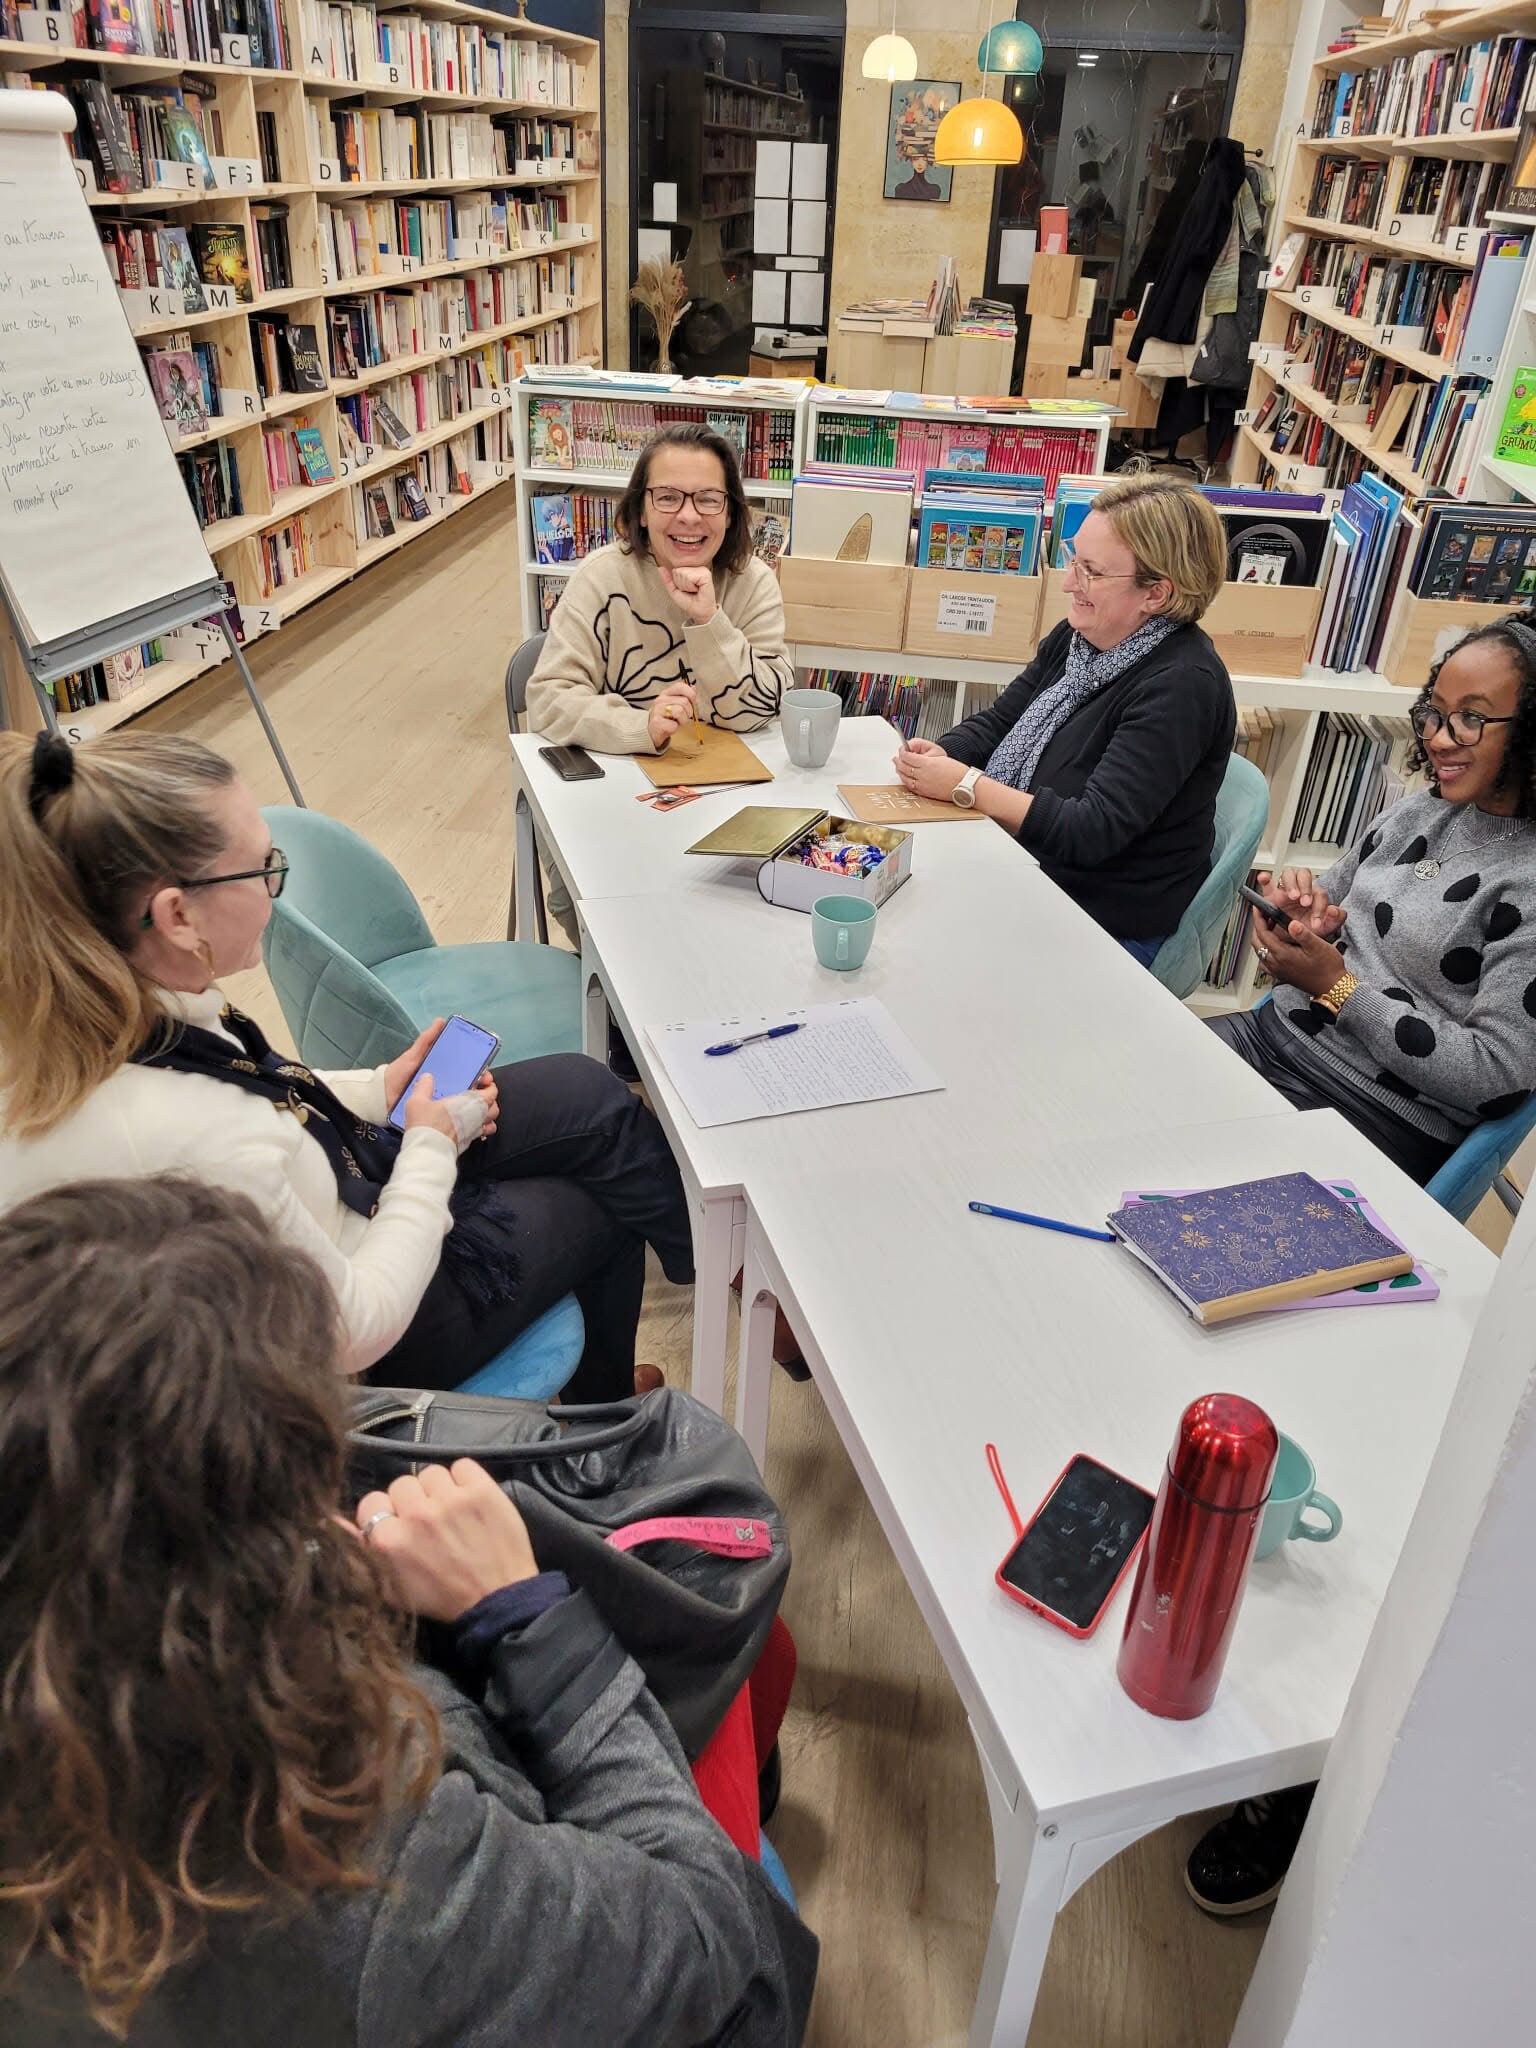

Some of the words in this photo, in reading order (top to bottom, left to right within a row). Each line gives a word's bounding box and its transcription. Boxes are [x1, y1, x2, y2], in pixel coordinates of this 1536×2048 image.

[46, 17, 59, 41] B
[229, 40, 241, 60] C
[311, 46, 323, 64] A
[389, 67, 399, 83] B
[538, 80, 547, 93] C
[1460, 108, 1475, 126] C
[1296, 122, 1306, 136] A
[1341, 121, 1350, 135] B
[320, 164, 331, 180] D
[536, 163, 543, 175] E
[561, 161, 567, 172] F
[186, 168, 196, 188] E
[228, 166, 237, 185] F
[581, 226, 587, 238] L
[1388, 220, 1401, 236] D
[540, 233, 547, 245] K
[1455, 233, 1469, 251] E
[401, 259, 412, 273] H
[210, 289, 229, 307] M
[566, 297, 573, 309] N
[1301, 290, 1312, 303] G
[149, 294, 161, 315] K
[167, 295, 176, 315] L
[440, 336, 452, 349] M
[1380, 329, 1394, 345] H
[1283, 367, 1291, 379] K
[244, 396, 254, 414] R
[491, 392, 502, 406] Q
[1238, 412, 1250, 423] M
[1331, 408, 1339, 419] L
[366, 446, 374, 460] P
[495, 466, 503, 477] U
[1288, 468, 1299, 480] N
[438, 496, 446, 509] T
[1331, 499, 1341, 512] P
[259, 611, 271, 626] Z
[195, 643, 208, 660] T
[69, 727, 81, 744] S
